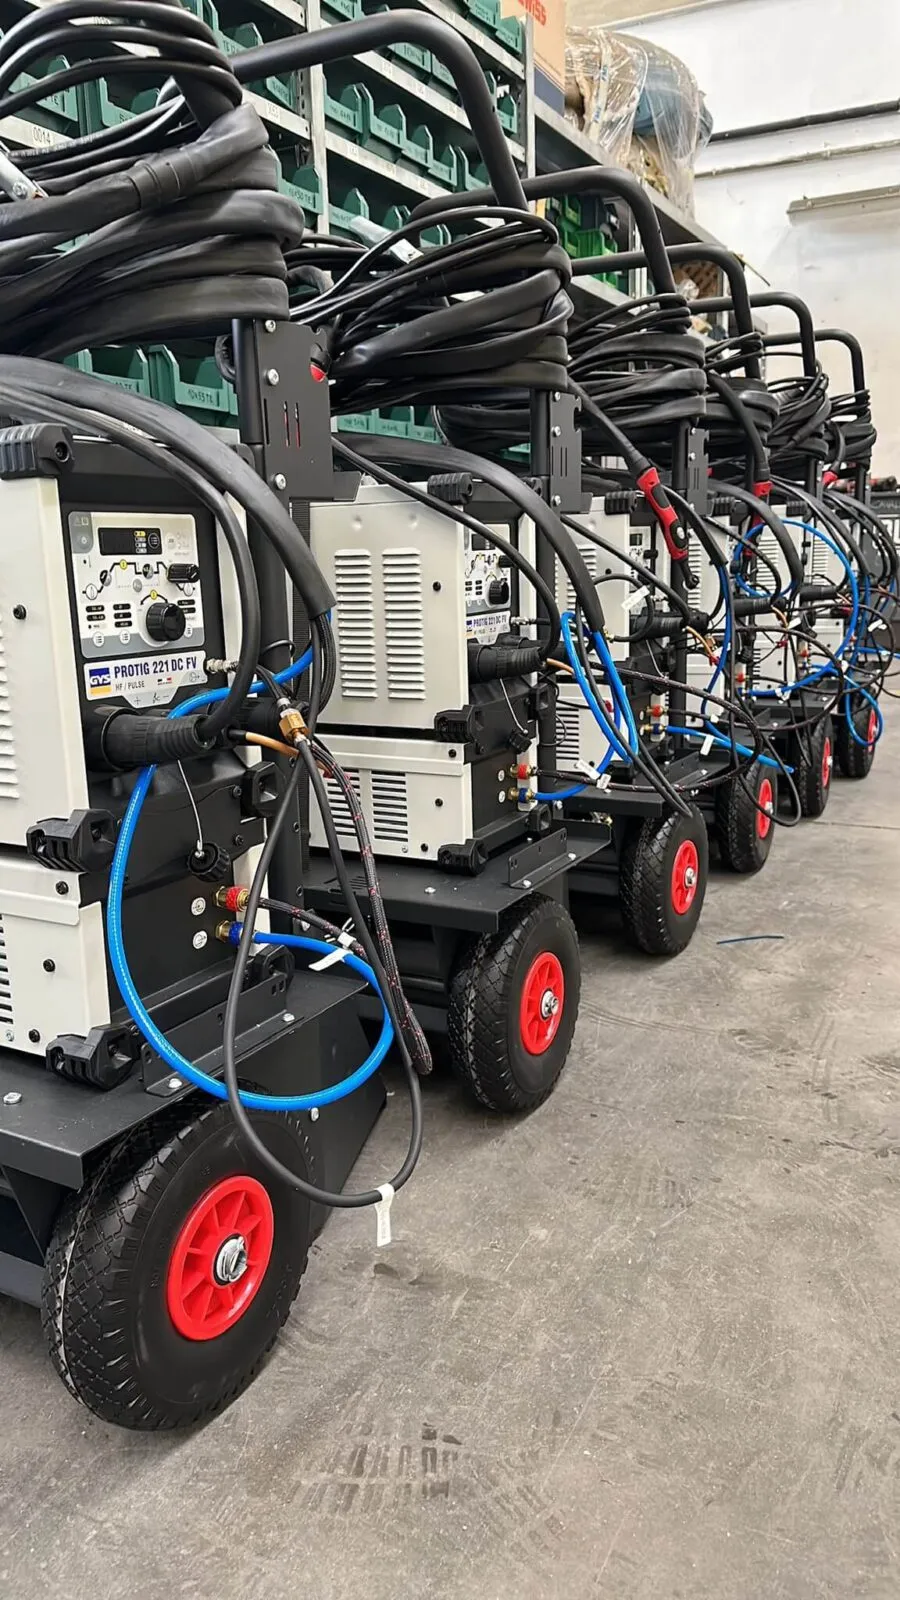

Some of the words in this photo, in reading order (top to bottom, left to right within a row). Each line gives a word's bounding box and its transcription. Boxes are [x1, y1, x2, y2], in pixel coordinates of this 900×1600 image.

[518, 0, 546, 26] WISS
[32, 126, 51, 145] 0014
[114, 662, 150, 679] PROTIG
[152, 659, 169, 675] 221
[171, 657, 184, 671] DC
[186, 656, 197, 669] FV
[90, 674, 111, 686] GYS
[115, 682, 123, 692] HF
[127, 679, 145, 690] PULSE
